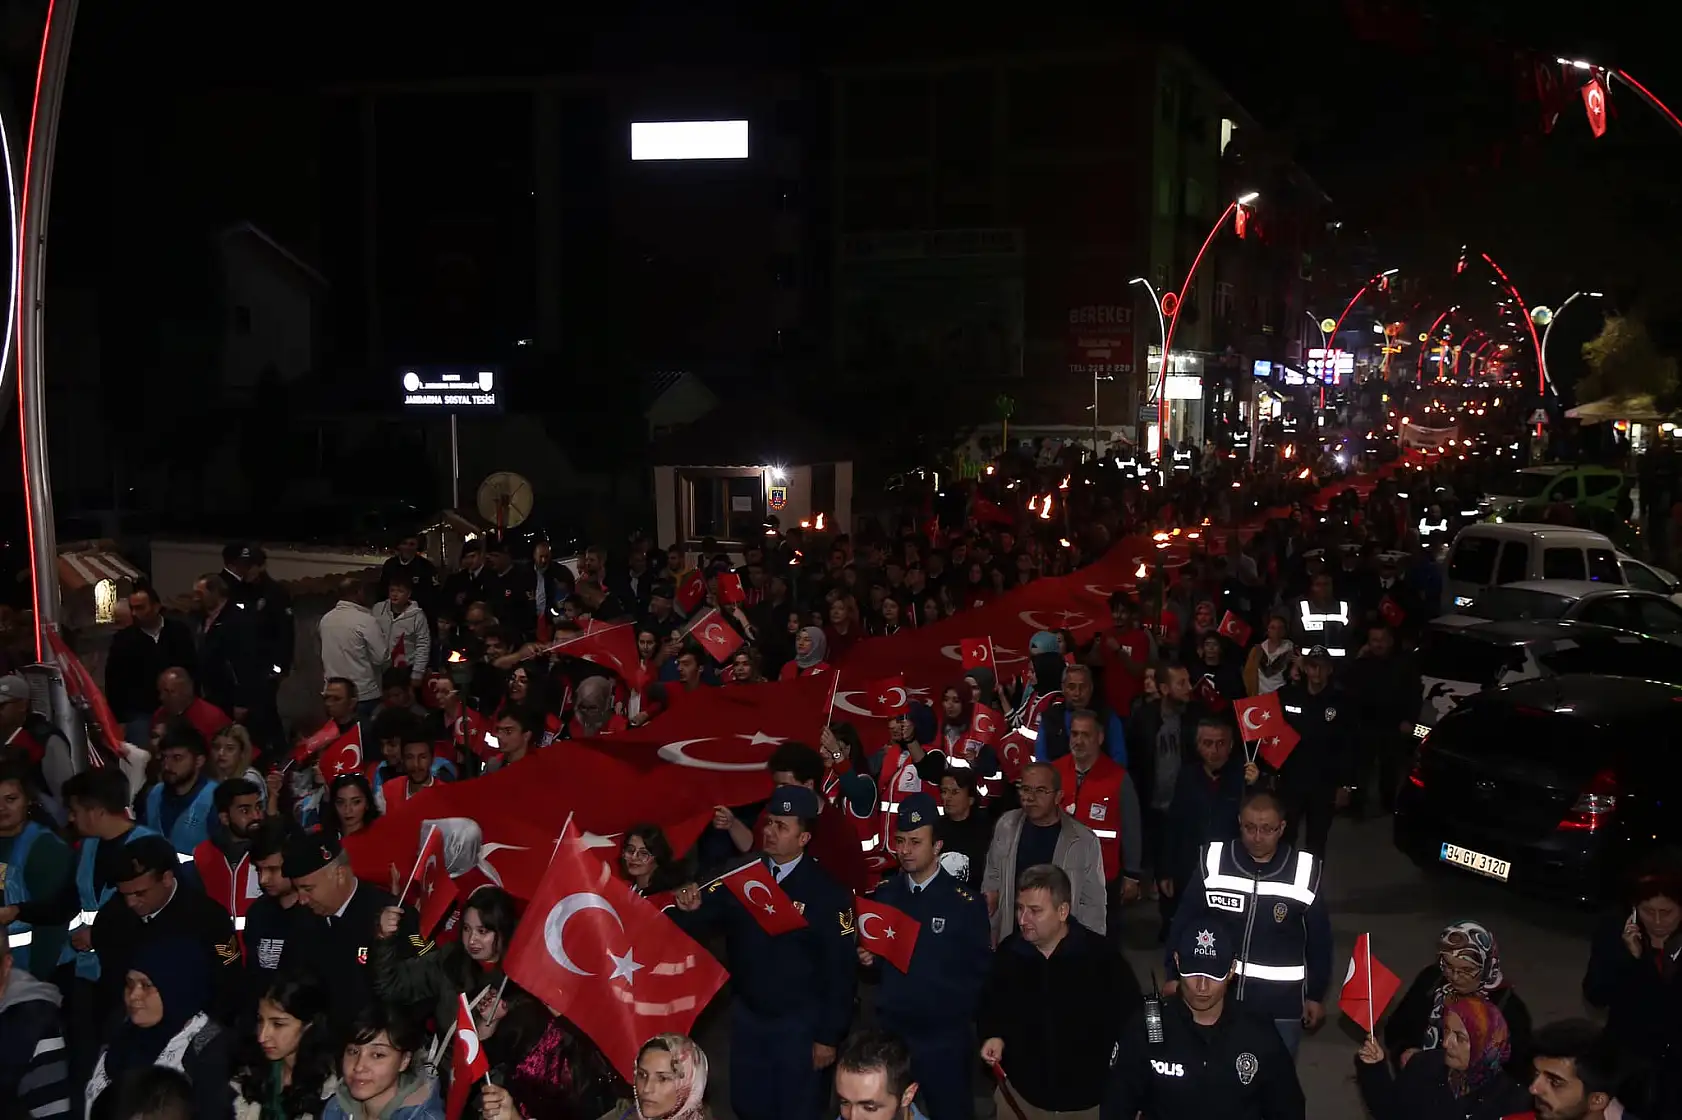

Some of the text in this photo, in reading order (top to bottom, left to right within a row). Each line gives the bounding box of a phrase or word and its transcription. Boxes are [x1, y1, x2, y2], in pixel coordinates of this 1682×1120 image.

[1069, 304, 1132, 324] BEREKET
[1447, 846, 1459, 861] 34
[1479, 856, 1507, 875] 3120
